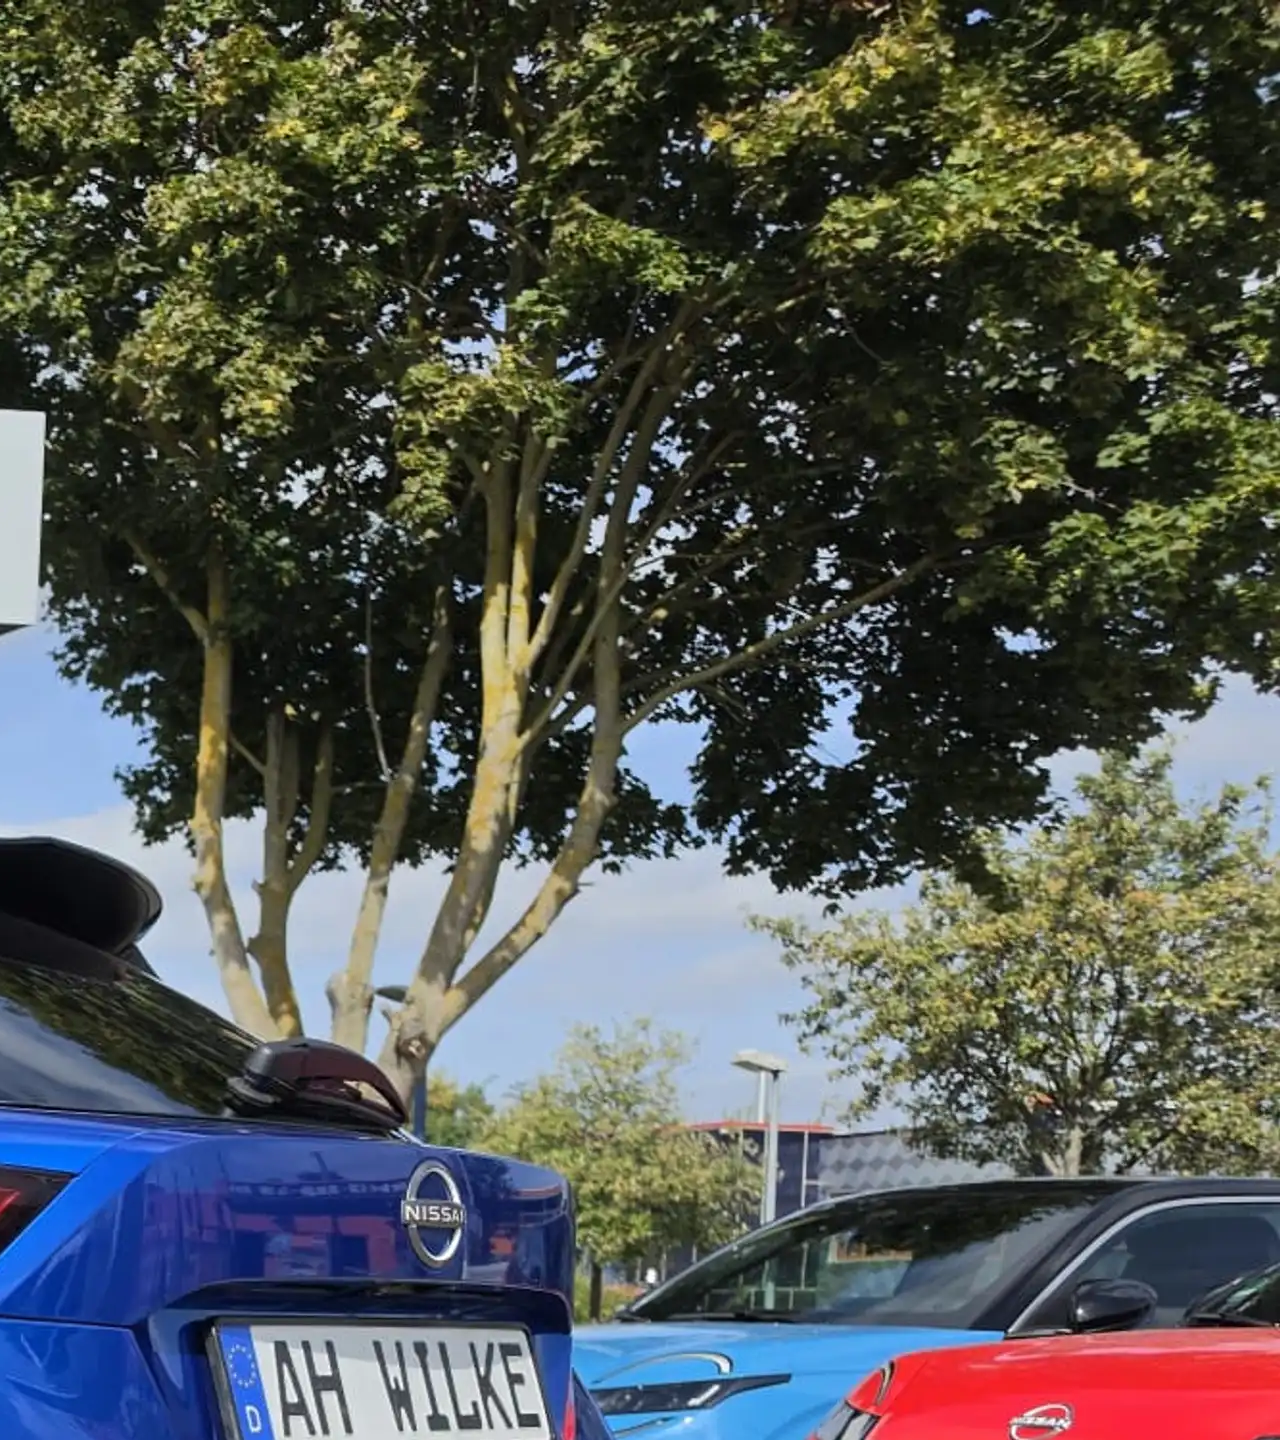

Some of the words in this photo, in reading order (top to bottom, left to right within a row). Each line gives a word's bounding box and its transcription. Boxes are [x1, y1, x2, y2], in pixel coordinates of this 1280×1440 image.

[245, 1404, 262, 1433] D
[273, 1340, 354, 1437] AH
[372, 1340, 541, 1432] WILKE
